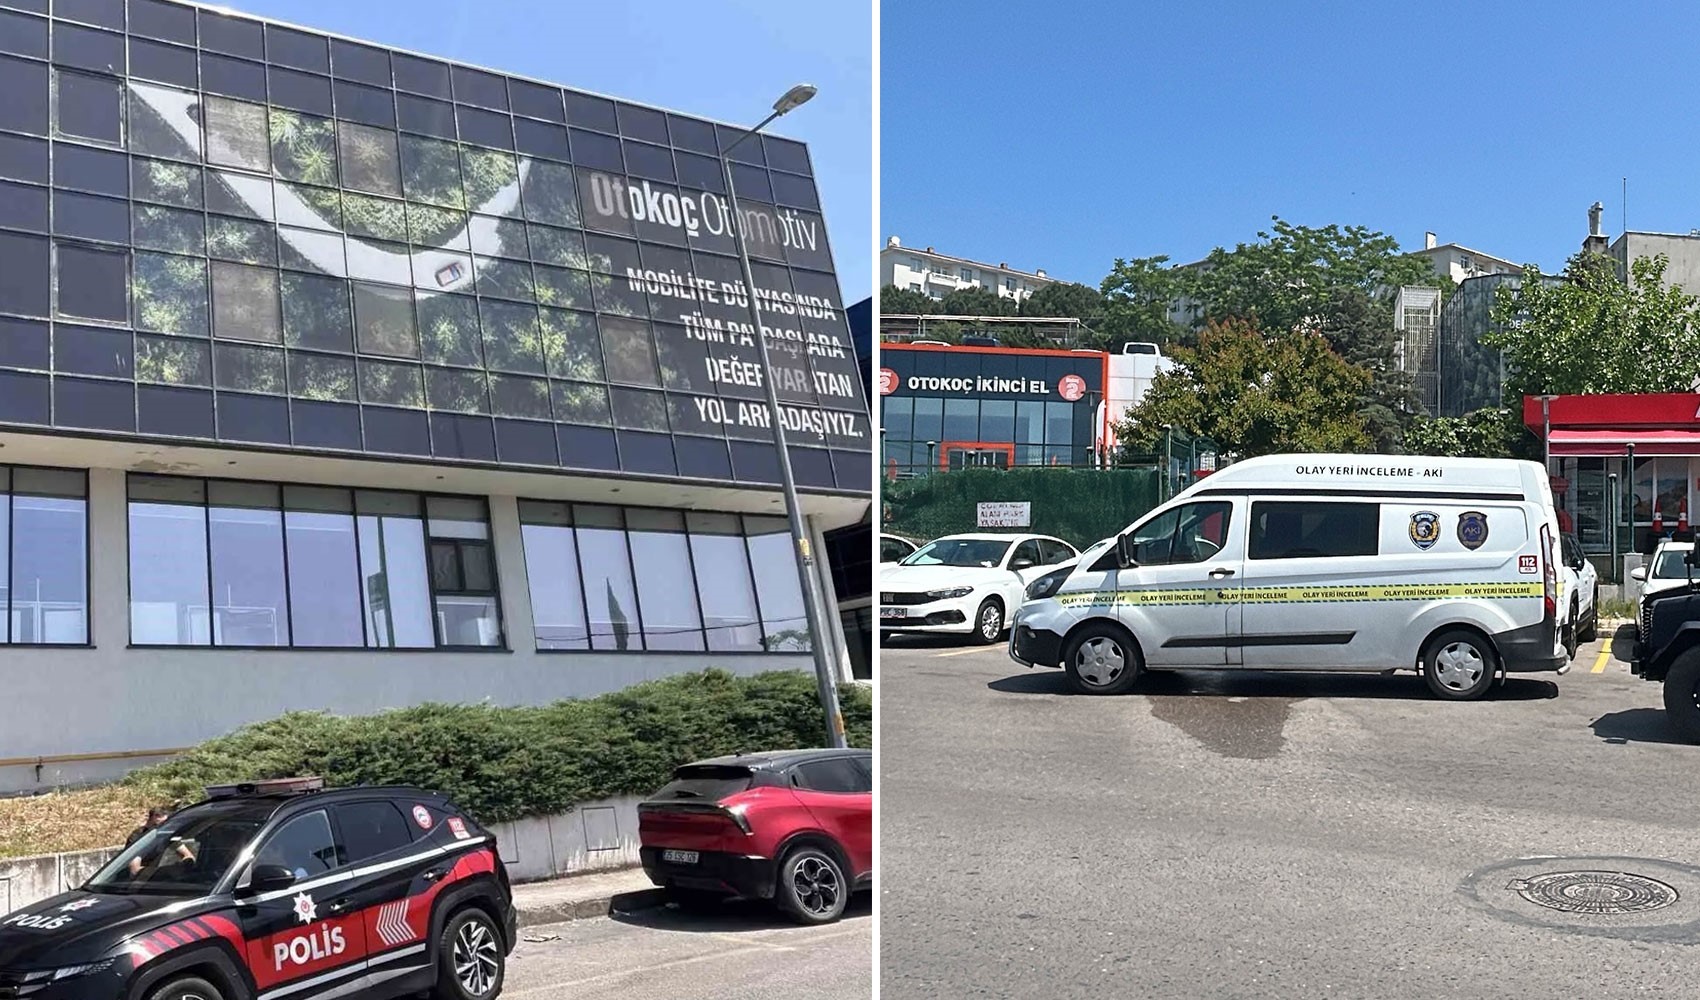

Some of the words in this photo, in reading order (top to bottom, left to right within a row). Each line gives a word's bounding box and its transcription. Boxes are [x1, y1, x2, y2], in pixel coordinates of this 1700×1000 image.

[626, 267, 720, 304] MOBİLİTE
[680, 311, 724, 343] TÜM
[908, 376, 973, 394] OTOKOÇ
[976, 375, 1026, 393] İKİNCİ
[1029, 381, 1050, 394] EL
[694, 397, 734, 425] YOL
[1295, 466, 1326, 475] OLAY
[1328, 465, 1354, 476] YERİ
[1356, 465, 1414, 477] İNCELEME
[1423, 467, 1443, 477] AKİ
[1521, 557, 1536, 566] 112
[273, 922, 346, 971] POLİS
